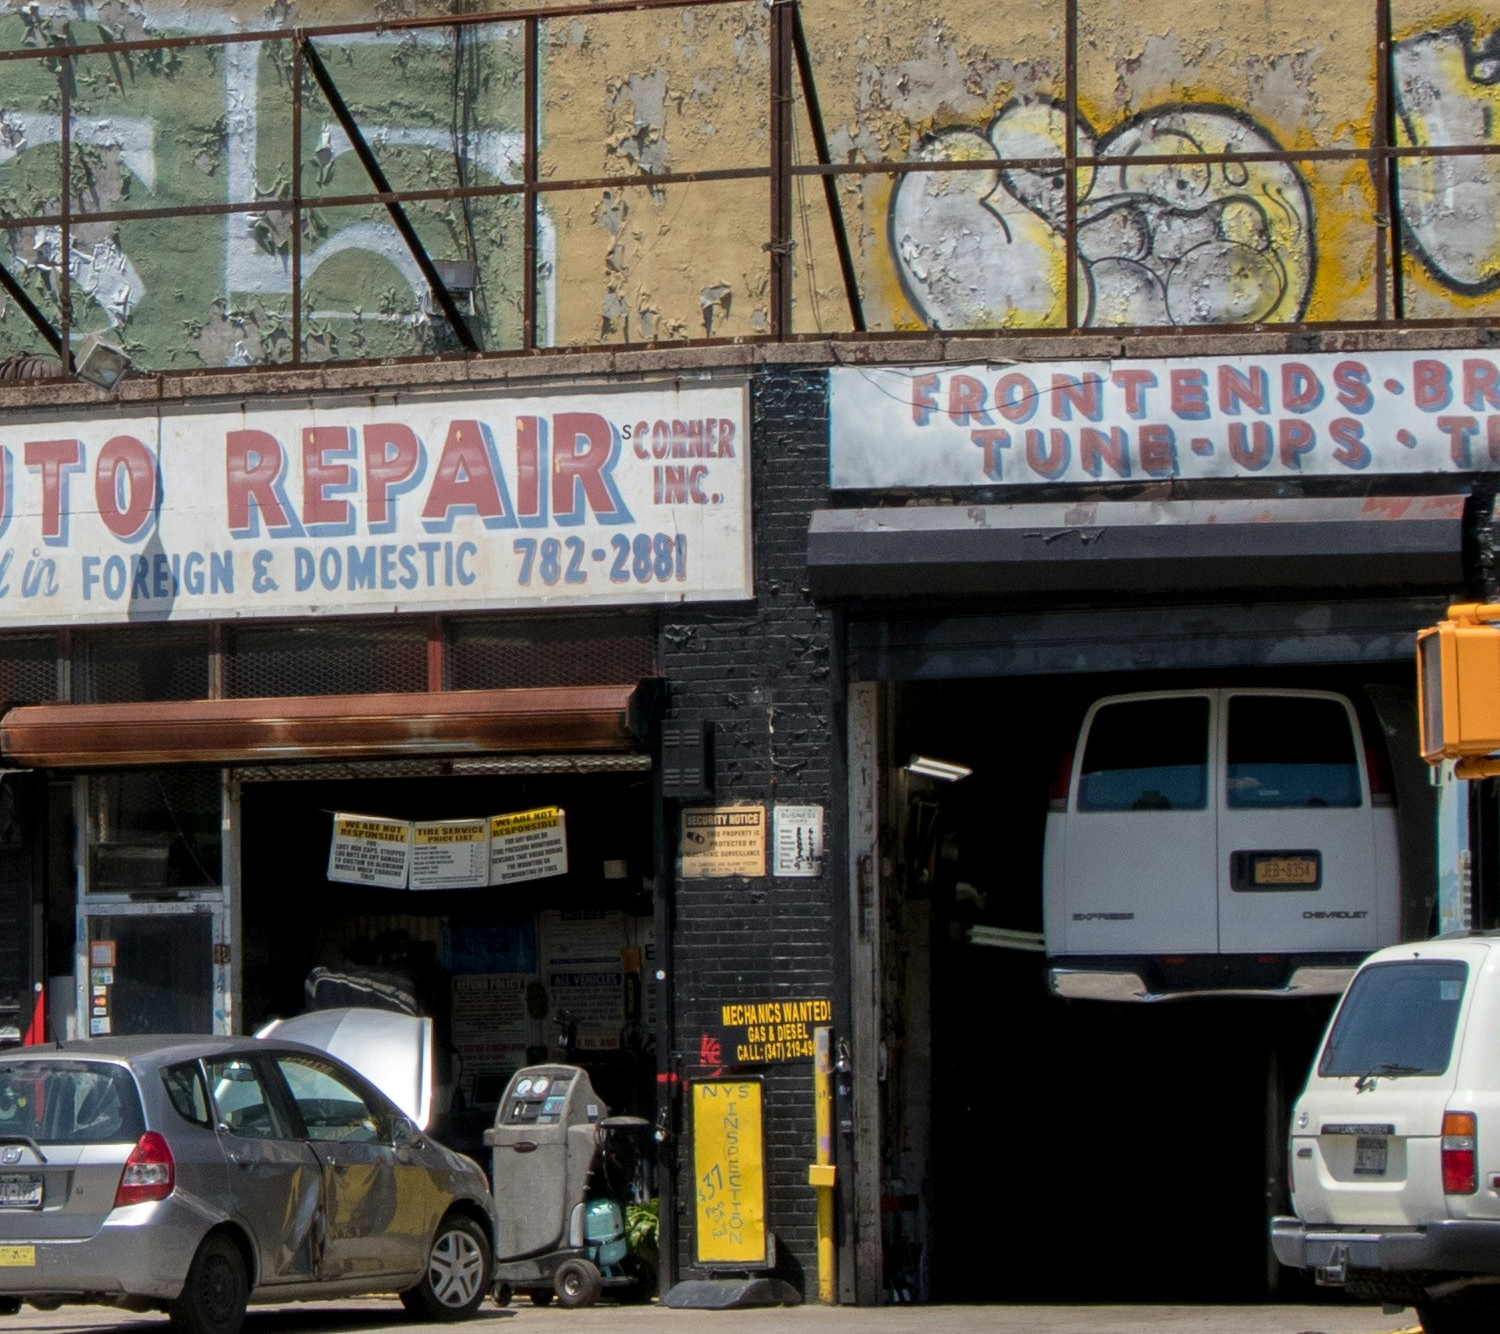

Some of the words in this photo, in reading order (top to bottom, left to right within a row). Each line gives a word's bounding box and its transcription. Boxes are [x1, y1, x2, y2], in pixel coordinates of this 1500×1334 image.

[911, 360, 1373, 427] FRONTENDS
[224, 412, 636, 540] REPAIR
[633, 418, 736, 460] CORNER
[653, 465, 725, 506] INC.
[21, 548, 59, 600] in
[82, 549, 234, 600] FOREIGN
[251, 550, 279, 594] &
[294, 541, 478, 593] DOMESTIC
[513, 533, 688, 586] 782-2881
[533, 810, 552, 820] NOT
[687, 814, 728, 826] SECURITY
[728, 813, 759, 825] NOTICE
[362, 822, 380, 831] ARE
[383, 824, 402, 833] NOT
[442, 826, 484, 834] SERVICE
[492, 819, 559, 837] RESPONSIBLE
[340, 828, 405, 843] RESPONSIBLE
[427, 835, 453, 843] PRICE
[455, 834, 473, 842] LIST
[1302, 910, 1368, 919] CHEVROLET
[554, 974, 571, 986] ALL
[573, 973, 618, 985] VEHICLES
[722, 1002, 782, 1026] MECHANICS
[782, 1000, 832, 1023] WANTED!
[748, 1025, 767, 1043] GAS
[768, 1025, 775, 1042] &
[777, 1022, 809, 1042] DIESEL
[737, 1044, 764, 1061] CALL:
[764, 1042, 785, 1063] (347)
[702, 1084, 750, 1099] NYS
